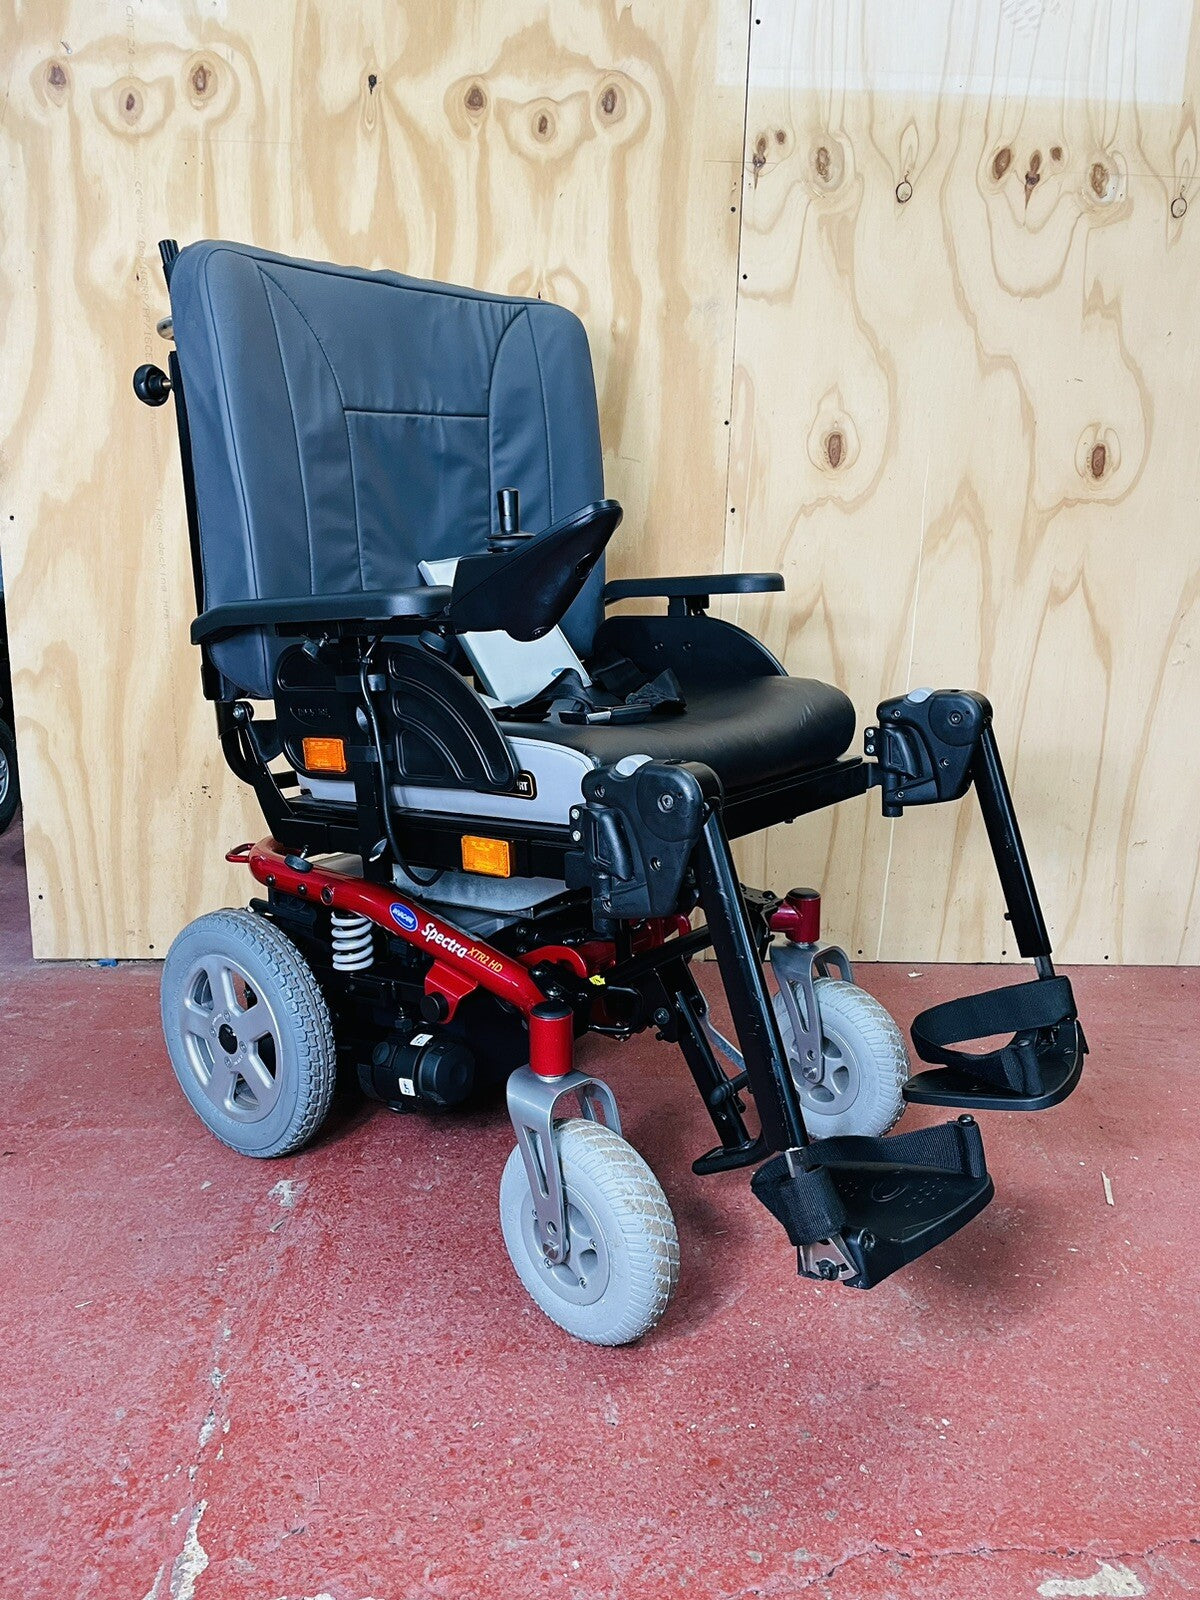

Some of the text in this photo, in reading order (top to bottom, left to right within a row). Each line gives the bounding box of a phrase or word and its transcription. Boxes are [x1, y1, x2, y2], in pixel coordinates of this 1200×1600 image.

[421, 922, 503, 973] Spectra XTR2 HD
